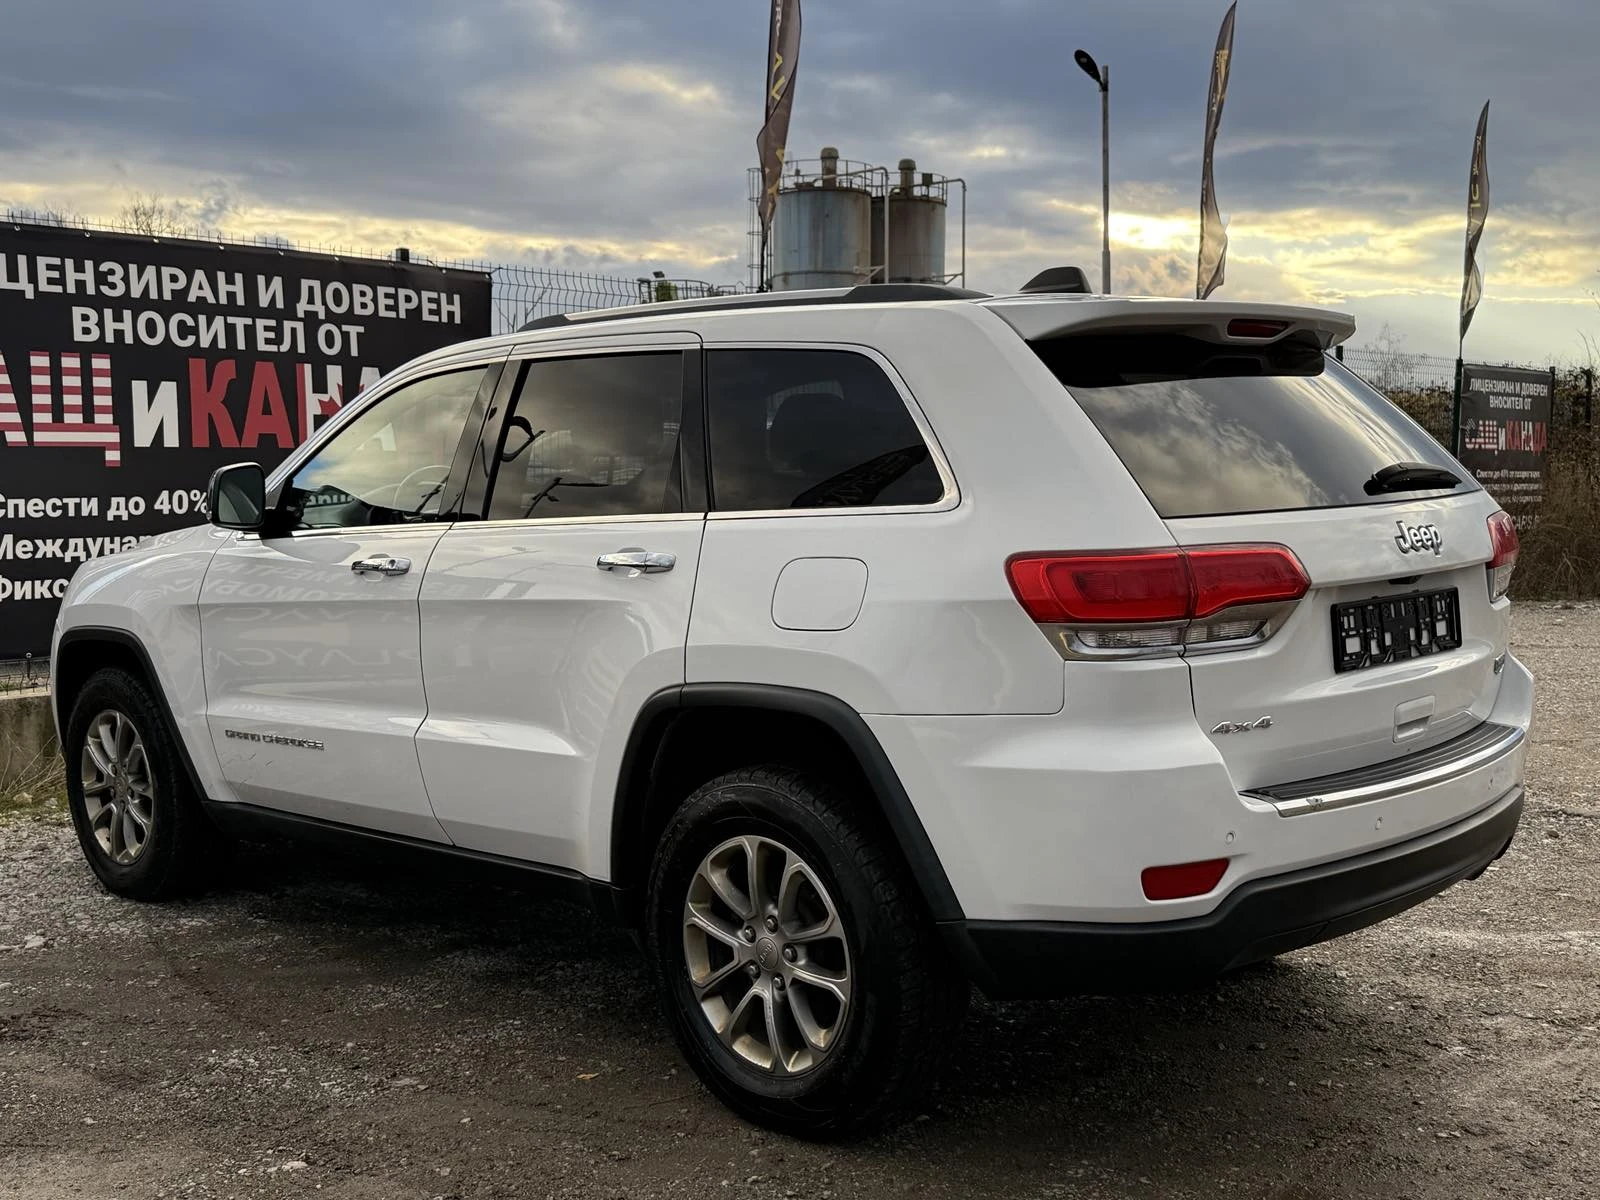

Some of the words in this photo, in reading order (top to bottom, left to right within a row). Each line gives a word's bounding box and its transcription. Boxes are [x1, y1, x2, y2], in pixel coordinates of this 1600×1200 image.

[258, 274, 284, 309] И
[296, 278, 461, 324] ДОВЕРЕН
[72, 306, 306, 354] ВНОСИТЕЛ
[317, 323, 364, 356] ОТ
[1521, 382, 1548, 397] ДОВЕРЕН
[188, 357, 382, 449] КАН
[1490, 396, 1523, 410] ВНОСИТЕЛ
[107, 496, 145, 520] до
[0, 534, 152, 562] Междуна
[1394, 520, 1442, 557] Jeep
[1210, 715, 1273, 735] 4x4
[224, 729, 261, 742] GRAND
[262, 733, 325, 750] CHEROKEE
